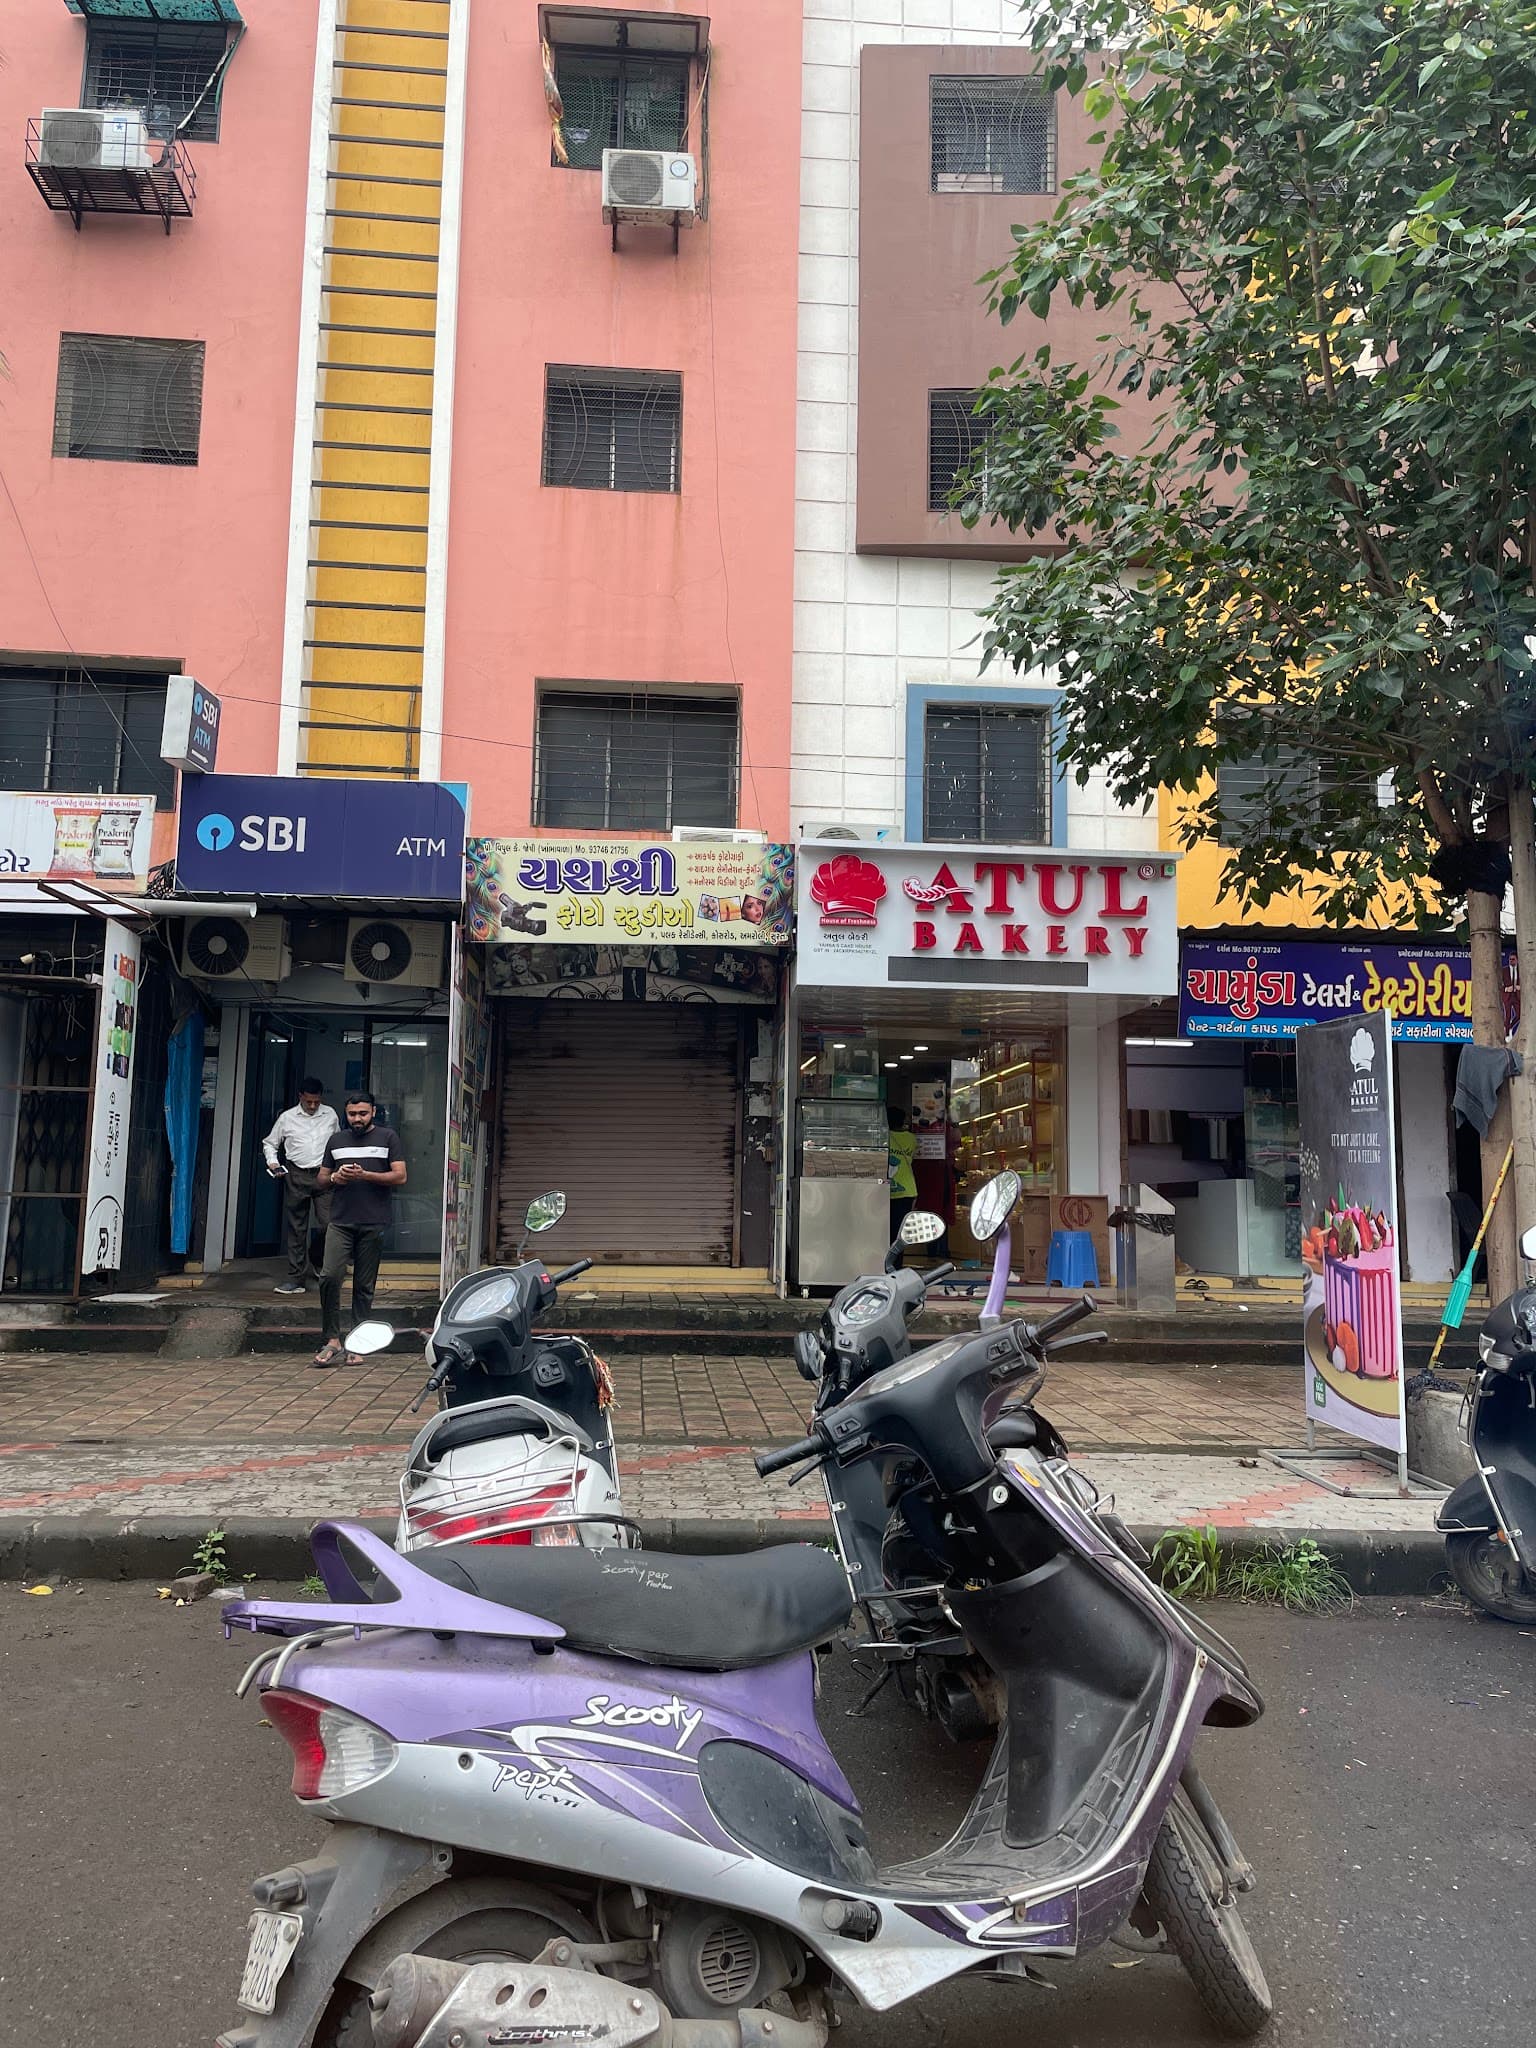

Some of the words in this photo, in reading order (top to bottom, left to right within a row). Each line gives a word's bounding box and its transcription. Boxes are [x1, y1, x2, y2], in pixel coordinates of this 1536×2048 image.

[202, 700, 218, 728] SBI
[193, 726, 211, 750] ATM
[239, 815, 307, 852] SBI
[396, 837, 446, 857] ATM
[517, 847, 679, 896] યશશ્રી
[915, 862, 1147, 918] ATUL
[556, 896, 605, 930] ફોટો
[613, 898, 695, 936] સ્ટુડીઓ
[823, 933, 845, 942] અતુલ
[847, 932, 868, 941] બેકરી
[912, 921, 1149, 957] BAKERY
[1187, 956, 1296, 1020] ચામુંડા
[1302, 973, 1354, 1008] ટેલર્સ
[1352, 989, 1361, 1001] &
[1251, 1024, 1278, 1033] કાપડ
[1350, 1078, 1378, 1095] ATUL
[1351, 1095, 1379, 1105] BAKERY
[569, 1694, 703, 1751] Scooty
